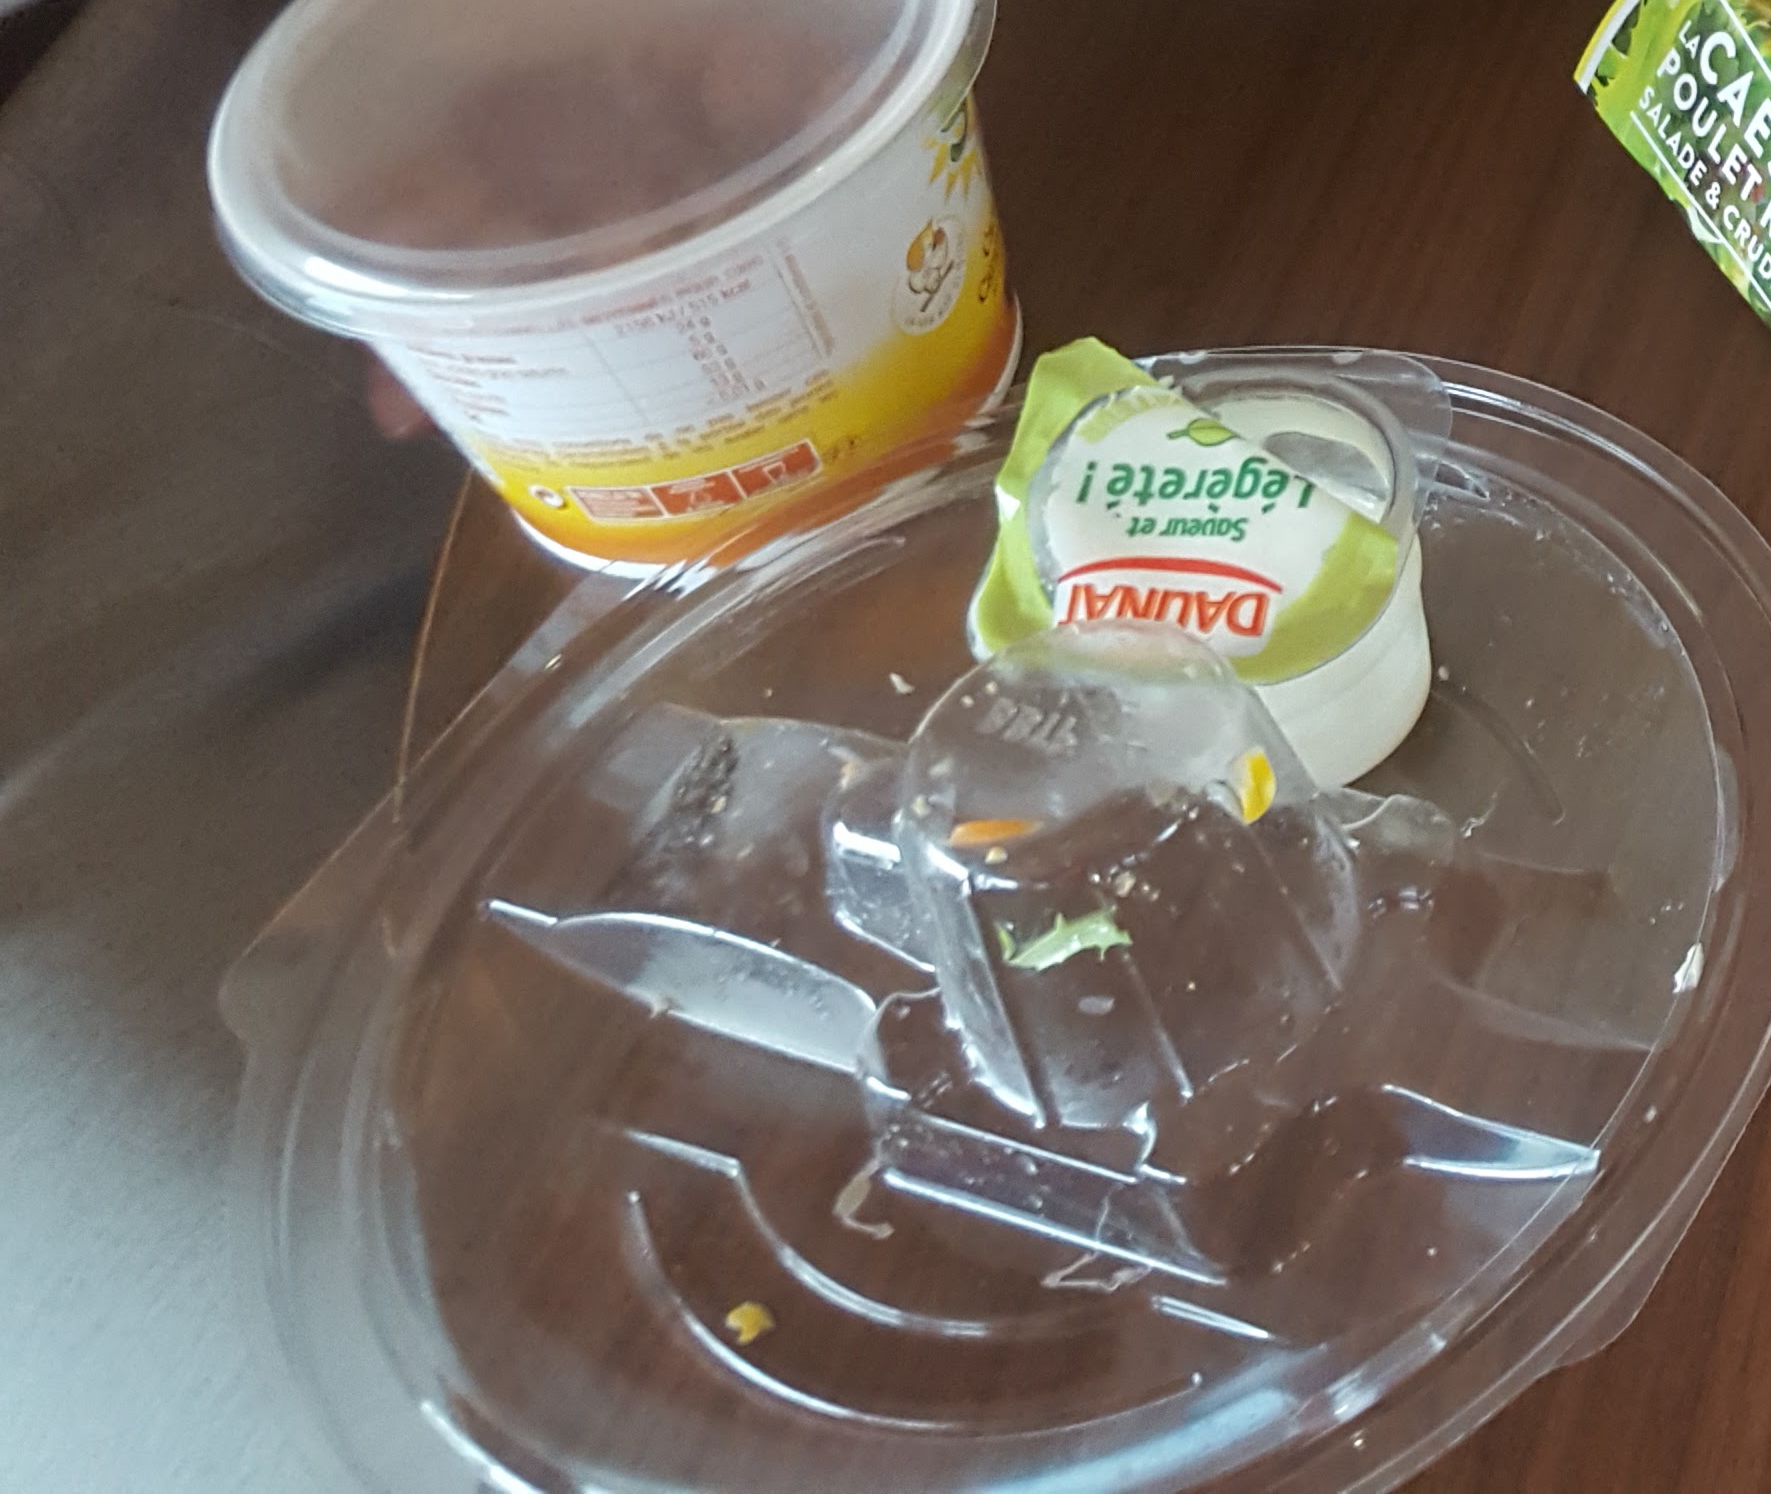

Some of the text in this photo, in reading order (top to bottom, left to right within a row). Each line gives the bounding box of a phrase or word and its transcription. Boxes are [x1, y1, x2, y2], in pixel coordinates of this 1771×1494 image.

[1679, 20, 1699, 59] LA
[1639, 86, 1708, 186] SALADE
[1705, 182, 1722, 210] &
[1656, 47, 1764, 202] POULET
[1076, 457, 1318, 514] Légèreté !
[1126, 516, 1248, 543] Saveur et
[1057, 583, 1270, 638] DAUNAT
